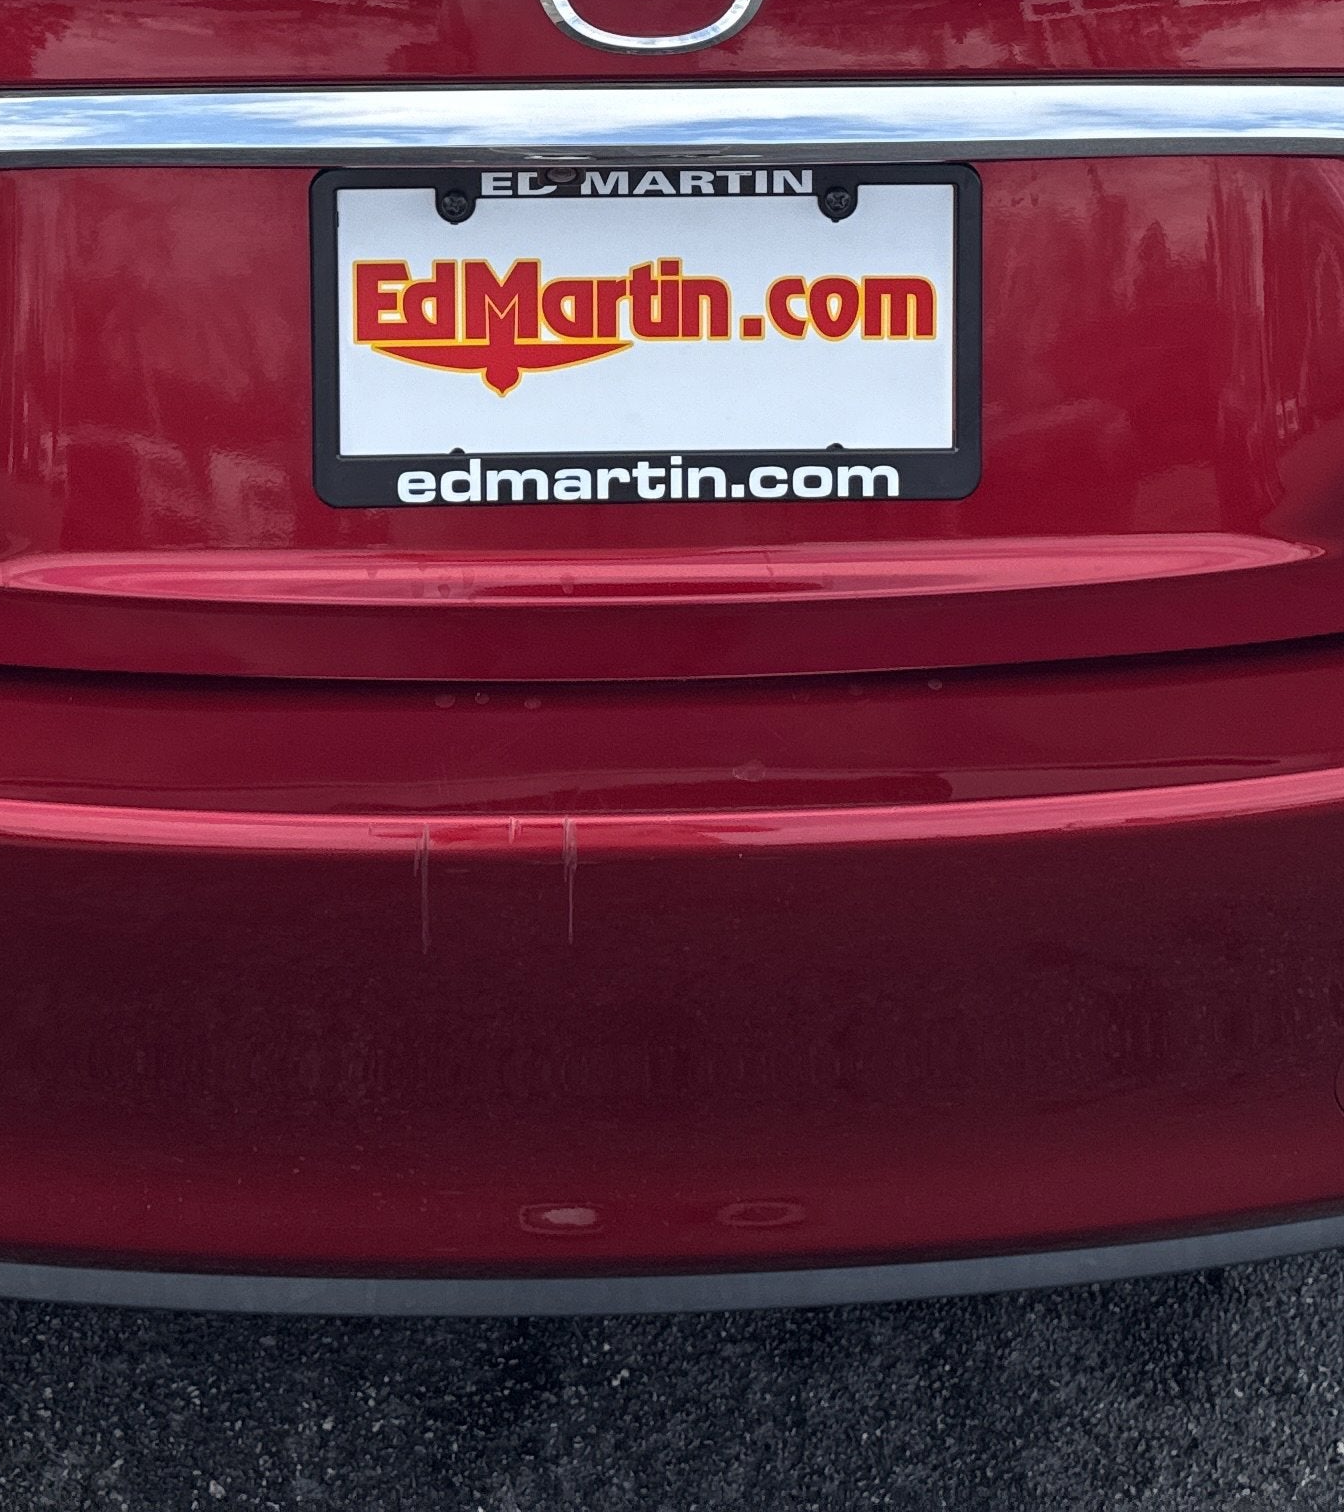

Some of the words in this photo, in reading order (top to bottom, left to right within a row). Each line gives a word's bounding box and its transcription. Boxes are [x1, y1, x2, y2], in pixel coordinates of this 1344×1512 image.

[581, 170, 813, 195] MARTIN
[353, 258, 937, 342] EdMartin.com
[397, 456, 899, 503] edmartin.com
